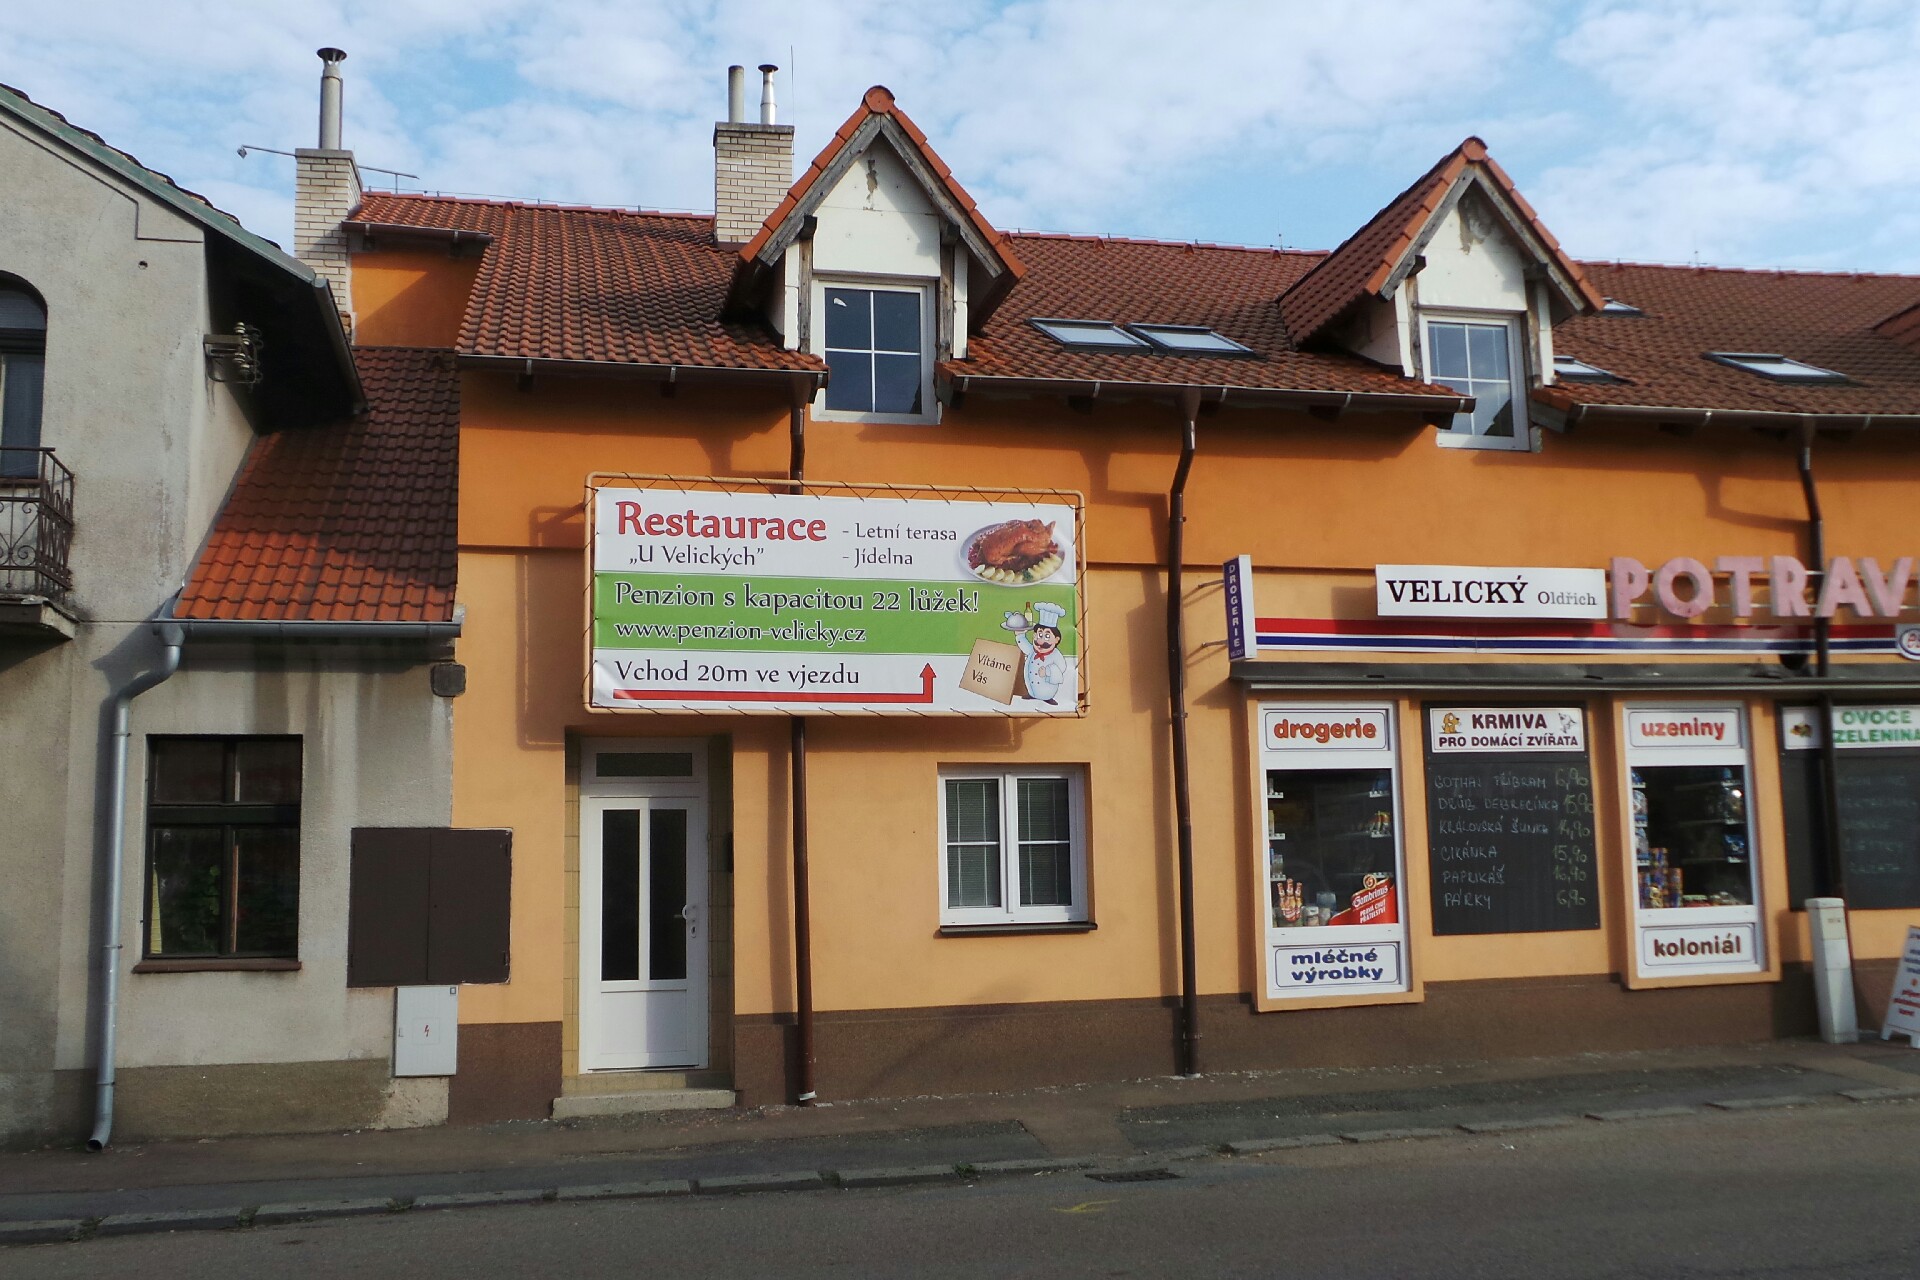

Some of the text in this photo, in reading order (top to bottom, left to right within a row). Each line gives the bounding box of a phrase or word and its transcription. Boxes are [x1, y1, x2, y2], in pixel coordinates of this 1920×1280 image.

[615, 501, 827, 541] Restaurace
[855, 523, 900, 539] Letní
[907, 526, 957, 541] terasa
[854, 547, 913, 569] Jídelna
[614, 580, 980, 615] Penzion s kapacitou 22 lůžek!
[1385, 575, 1598, 606] VELICKÝ Oldřich
[1610, 556, 1920, 619] POTRAV
[1228, 564, 1241, 648] DROGERIE
[614, 620, 867, 648] www.penzion-velicky.cz
[977, 653, 1012, 672] Vítáme
[614, 659, 860, 690] Vchod 20m ve vjezdu
[972, 669, 988, 685] Vás
[1472, 714, 1547, 730] KRMIVA
[1641, 717, 1725, 741] uzeniny
[1841, 710, 1912, 725] OVOCE
[1273, 717, 1377, 744] drogerie
[1438, 732, 1578, 748] PRO DOMÁCÍ ZVÍŘATA
[1832, 728, 1920, 744] ZELENINA
[1444, 888, 1491, 911] PÁRKY
[1291, 947, 1379, 966] mléčné
[1653, 932, 1742, 958] koloniál
[1291, 966, 1384, 984] výrobky
